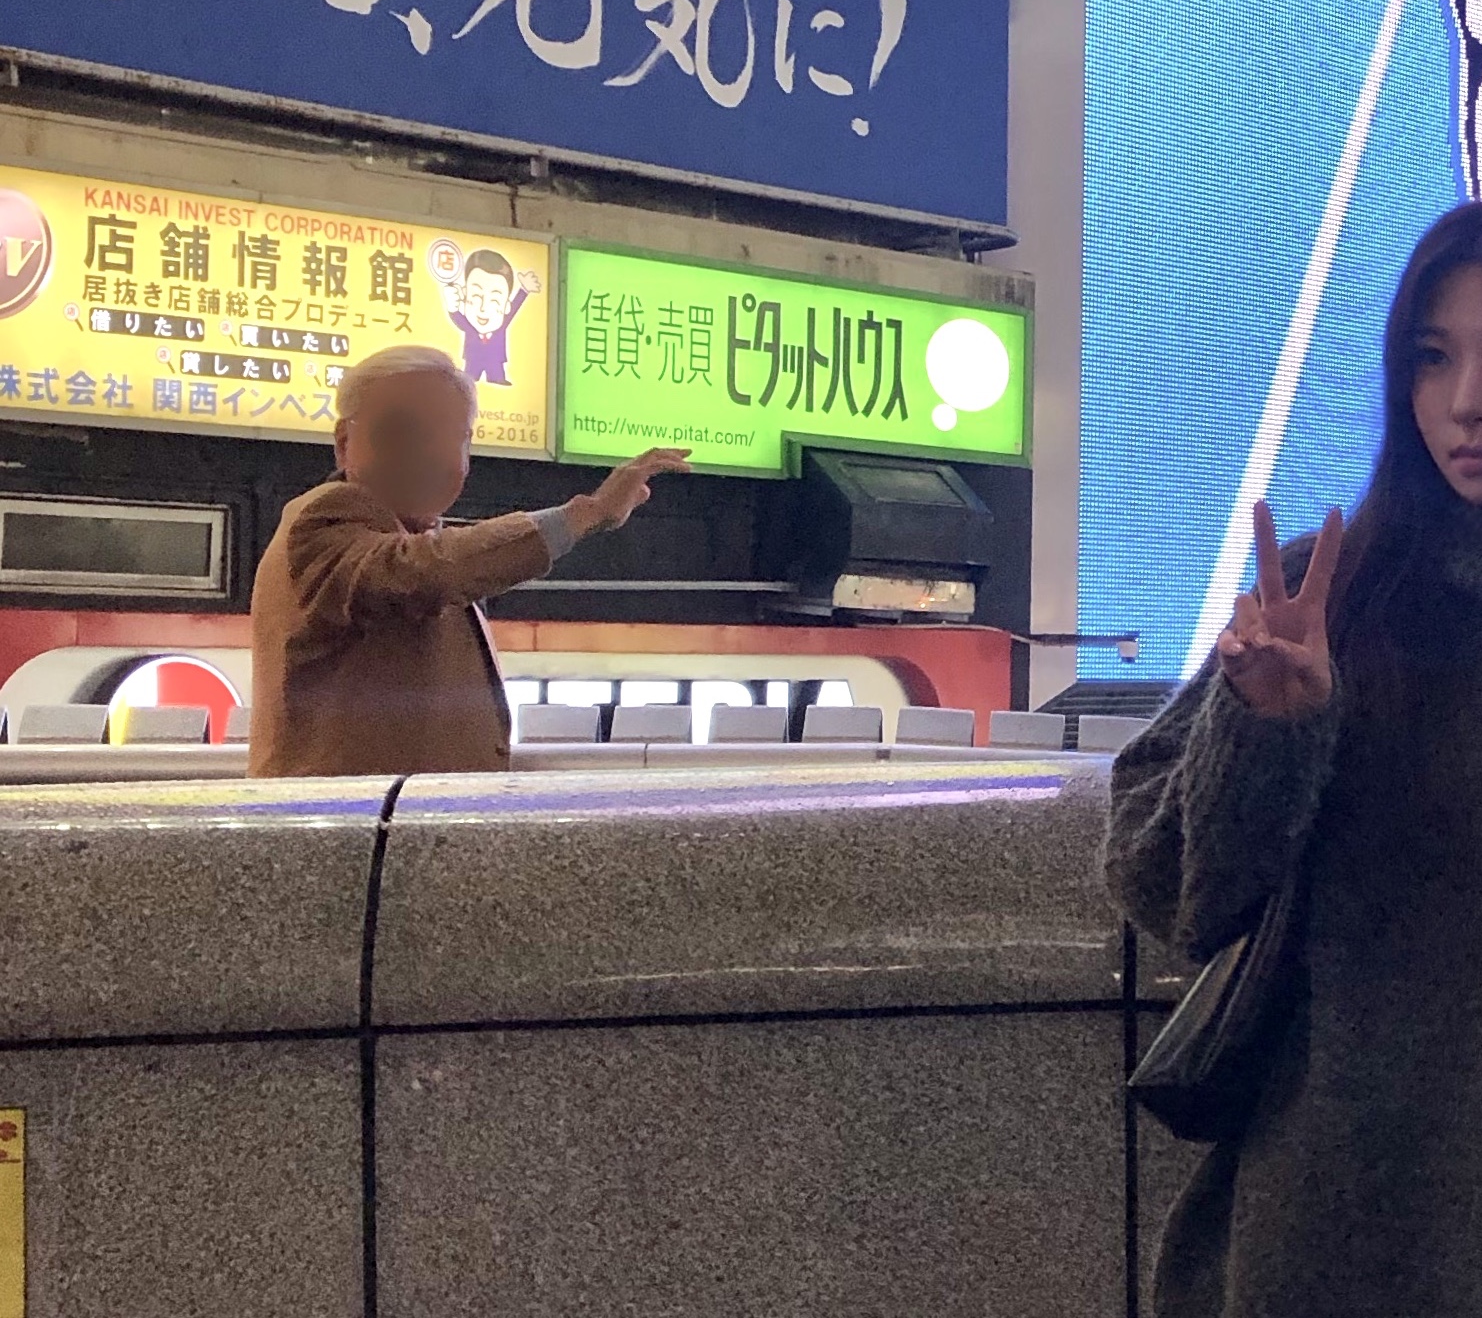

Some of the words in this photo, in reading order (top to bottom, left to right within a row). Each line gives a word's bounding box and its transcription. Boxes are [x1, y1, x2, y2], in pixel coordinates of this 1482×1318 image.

[84, 186, 169, 216] KANSAI
[178, 199, 256, 229] INVEST
[264, 212, 415, 251] CORPORATION
[83, 213, 415, 306] 店舗情報館
[437, 249, 455, 272] 店
[82, 274, 413, 334] 居抜き店舗総合プロデュース
[727, 292, 909, 423] ピタットハウス
[152, 376, 338, 422] 関西インベス
[475, 425, 540, 444] 6-2016
[573, 413, 756, 447] http://www.pitat.com/
